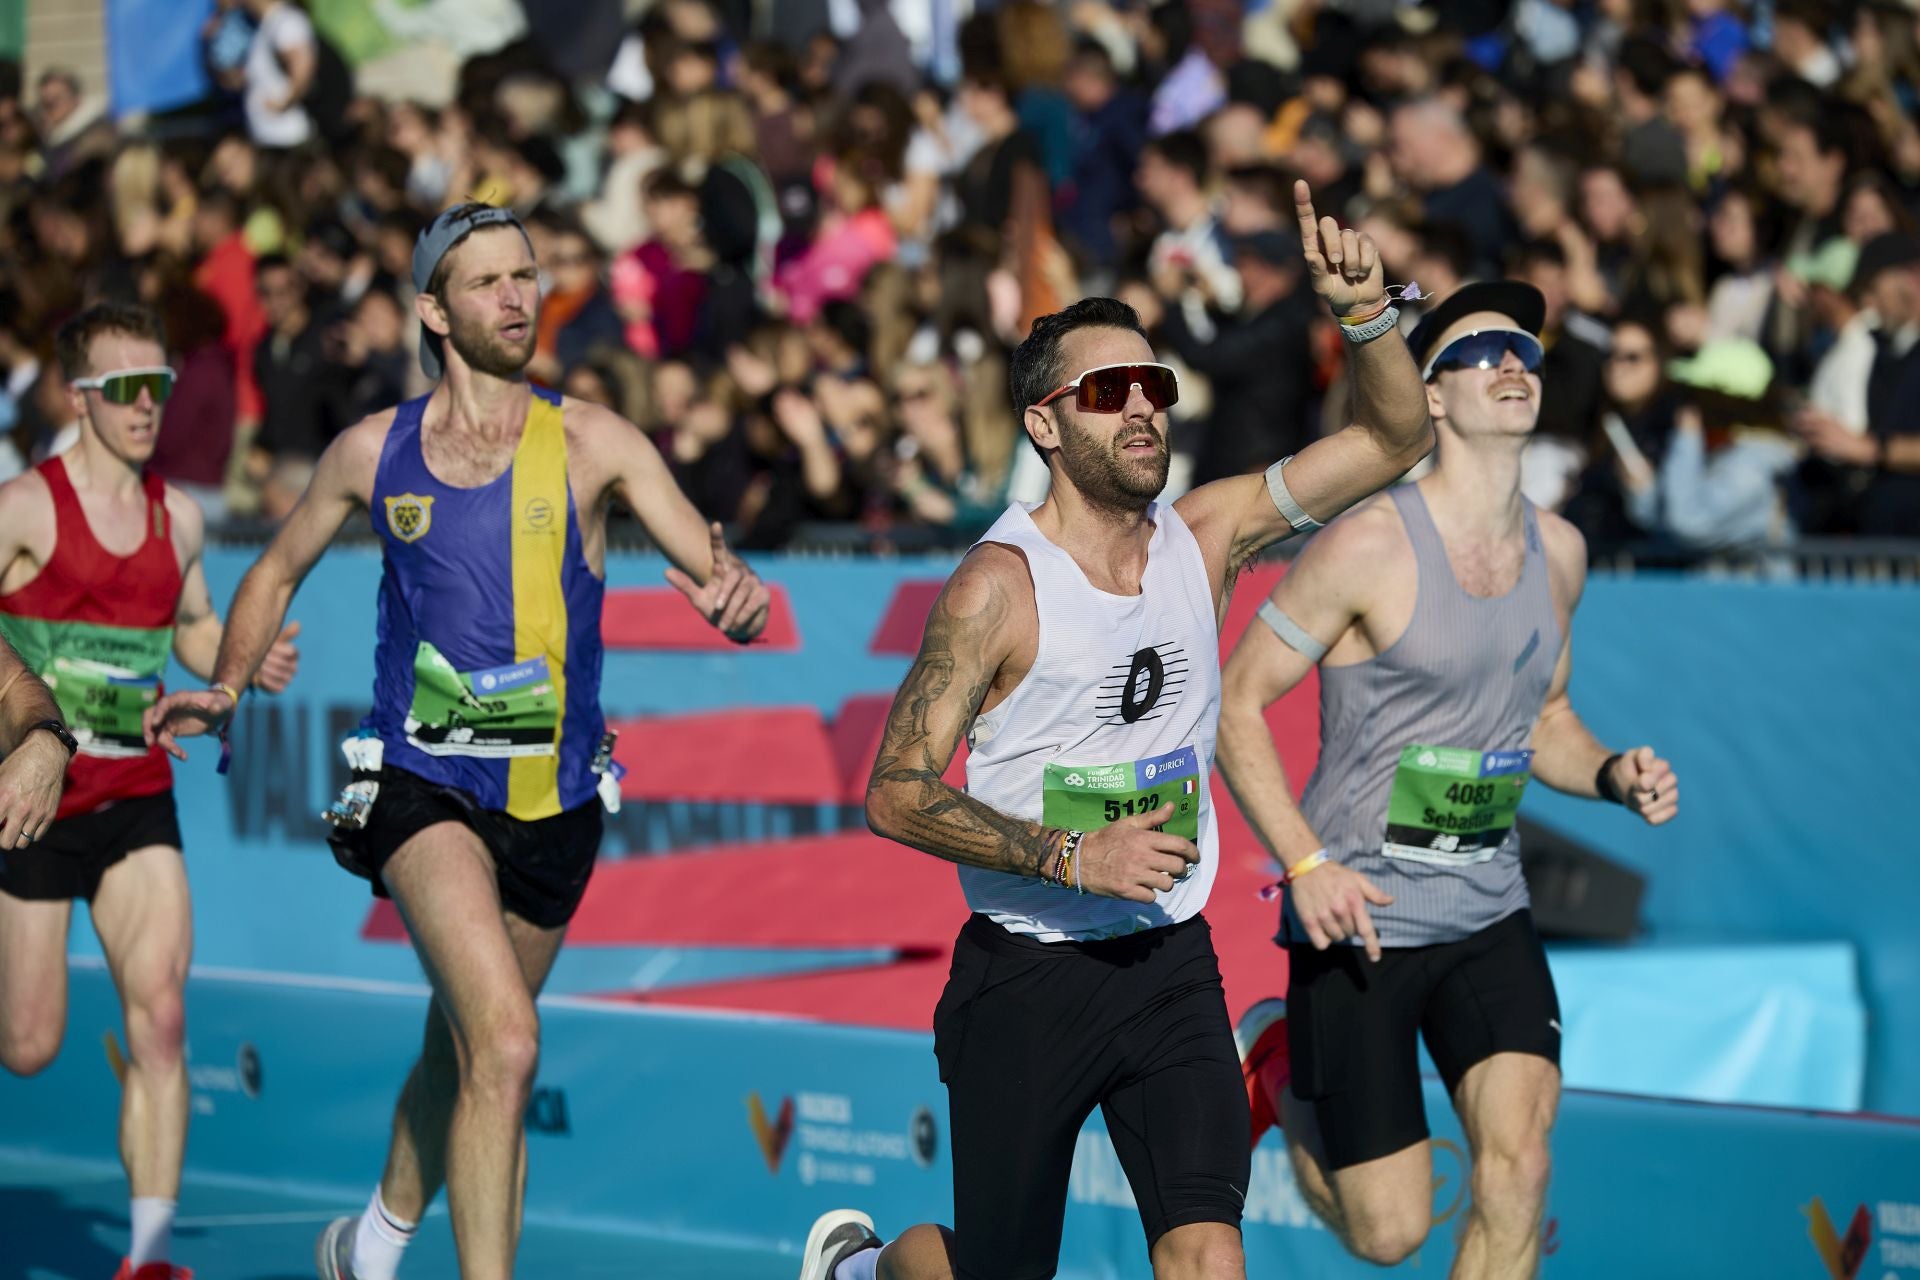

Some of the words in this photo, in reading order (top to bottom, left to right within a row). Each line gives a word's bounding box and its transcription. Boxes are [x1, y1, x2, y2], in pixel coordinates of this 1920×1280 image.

[1158, 757, 1185, 774] ZURICH
[1087, 773, 1125, 783] TRINIDAD
[1087, 781, 1126, 790] ALFONSO
[1444, 782, 1495, 806] 4083
[1103, 793, 1160, 823] 5122
